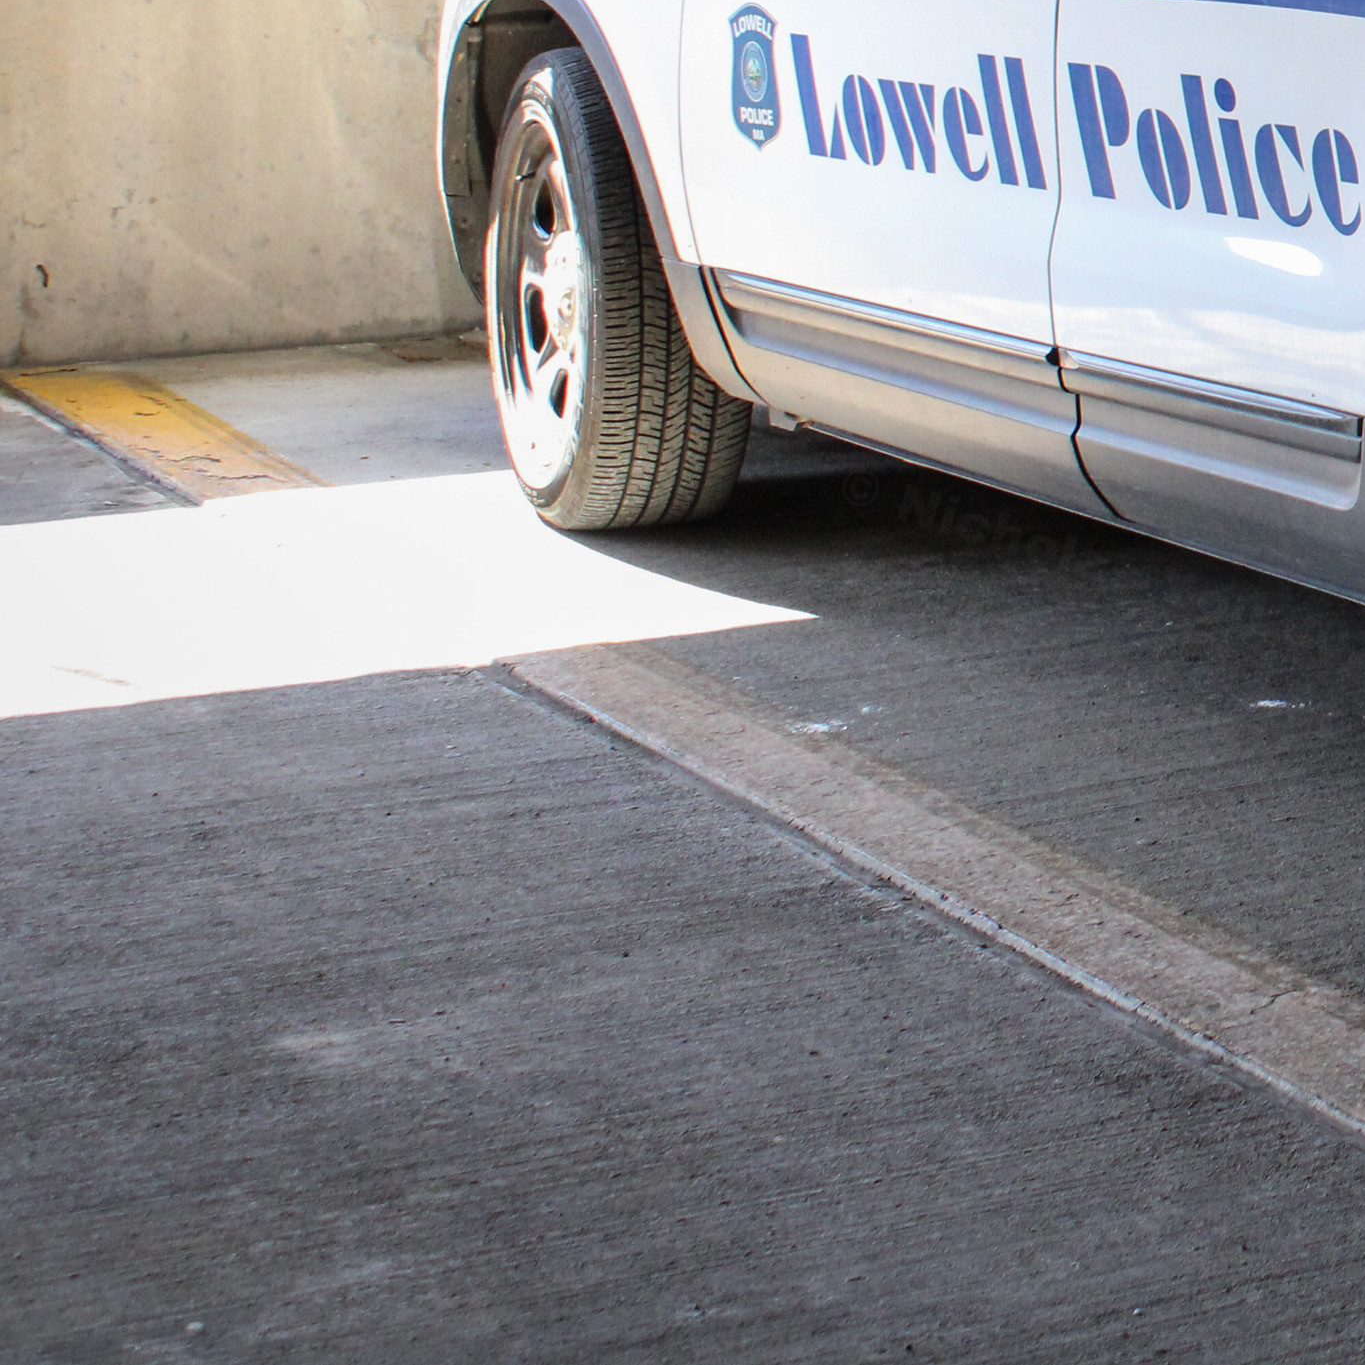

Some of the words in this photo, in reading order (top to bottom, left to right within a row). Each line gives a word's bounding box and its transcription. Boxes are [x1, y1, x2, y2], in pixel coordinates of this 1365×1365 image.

[733, 14, 773, 40] LOWELL
[740, 106, 774, 126] POLICE
[752, 128, 765, 141] MA
[790, 33, 1047, 190] Lowell
[1067, 62, 1362, 237] Police
